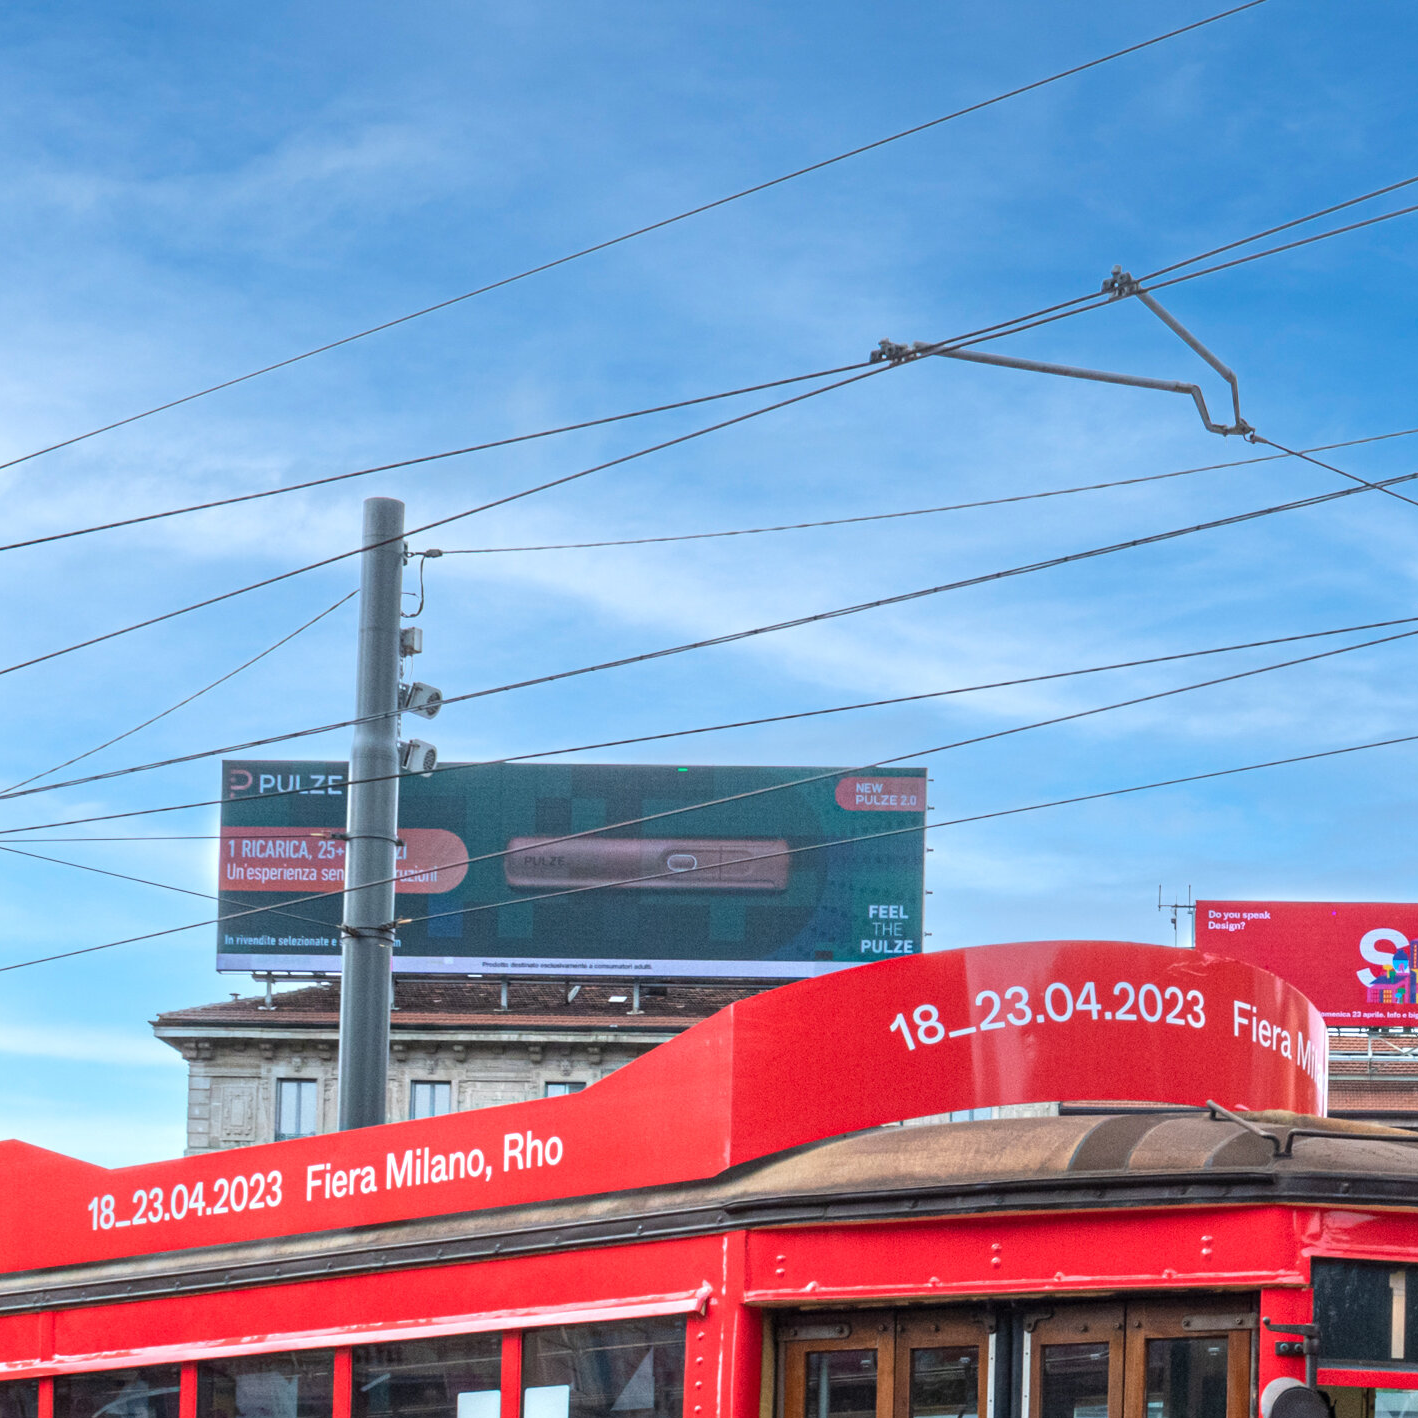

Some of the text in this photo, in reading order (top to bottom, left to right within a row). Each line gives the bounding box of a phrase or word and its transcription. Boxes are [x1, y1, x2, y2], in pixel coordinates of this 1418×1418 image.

[259, 773, 343, 796] PULZE
[855, 782, 884, 793] NEW
[855, 794, 917, 807] PULZE 2.0
[228, 840, 345, 861] 1 RICARICA, 25+
[524, 855, 566, 867] PULZE
[226, 863, 317, 885] Un'esperienza
[321, 869, 345, 881] sen
[868, 904, 909, 919] FEEL
[1208, 910, 1271, 921] Do you speak
[872, 922, 903, 937] THE
[1208, 921, 1246, 932] Design?
[224, 934, 234, 945] In
[236, 934, 276, 946] rivendite
[278, 935, 329, 947] selezionate
[331, 938, 337, 947] e
[860, 939, 914, 954] PULZE
[1356, 927, 1410, 988] S
[889, 981, 1207, 1051] 18_23.04.2023
[1232, 1000, 1292, 1060] Fiera
[87, 1130, 563, 1231] 18_23.04.2023 Fiera Milano, Rho
